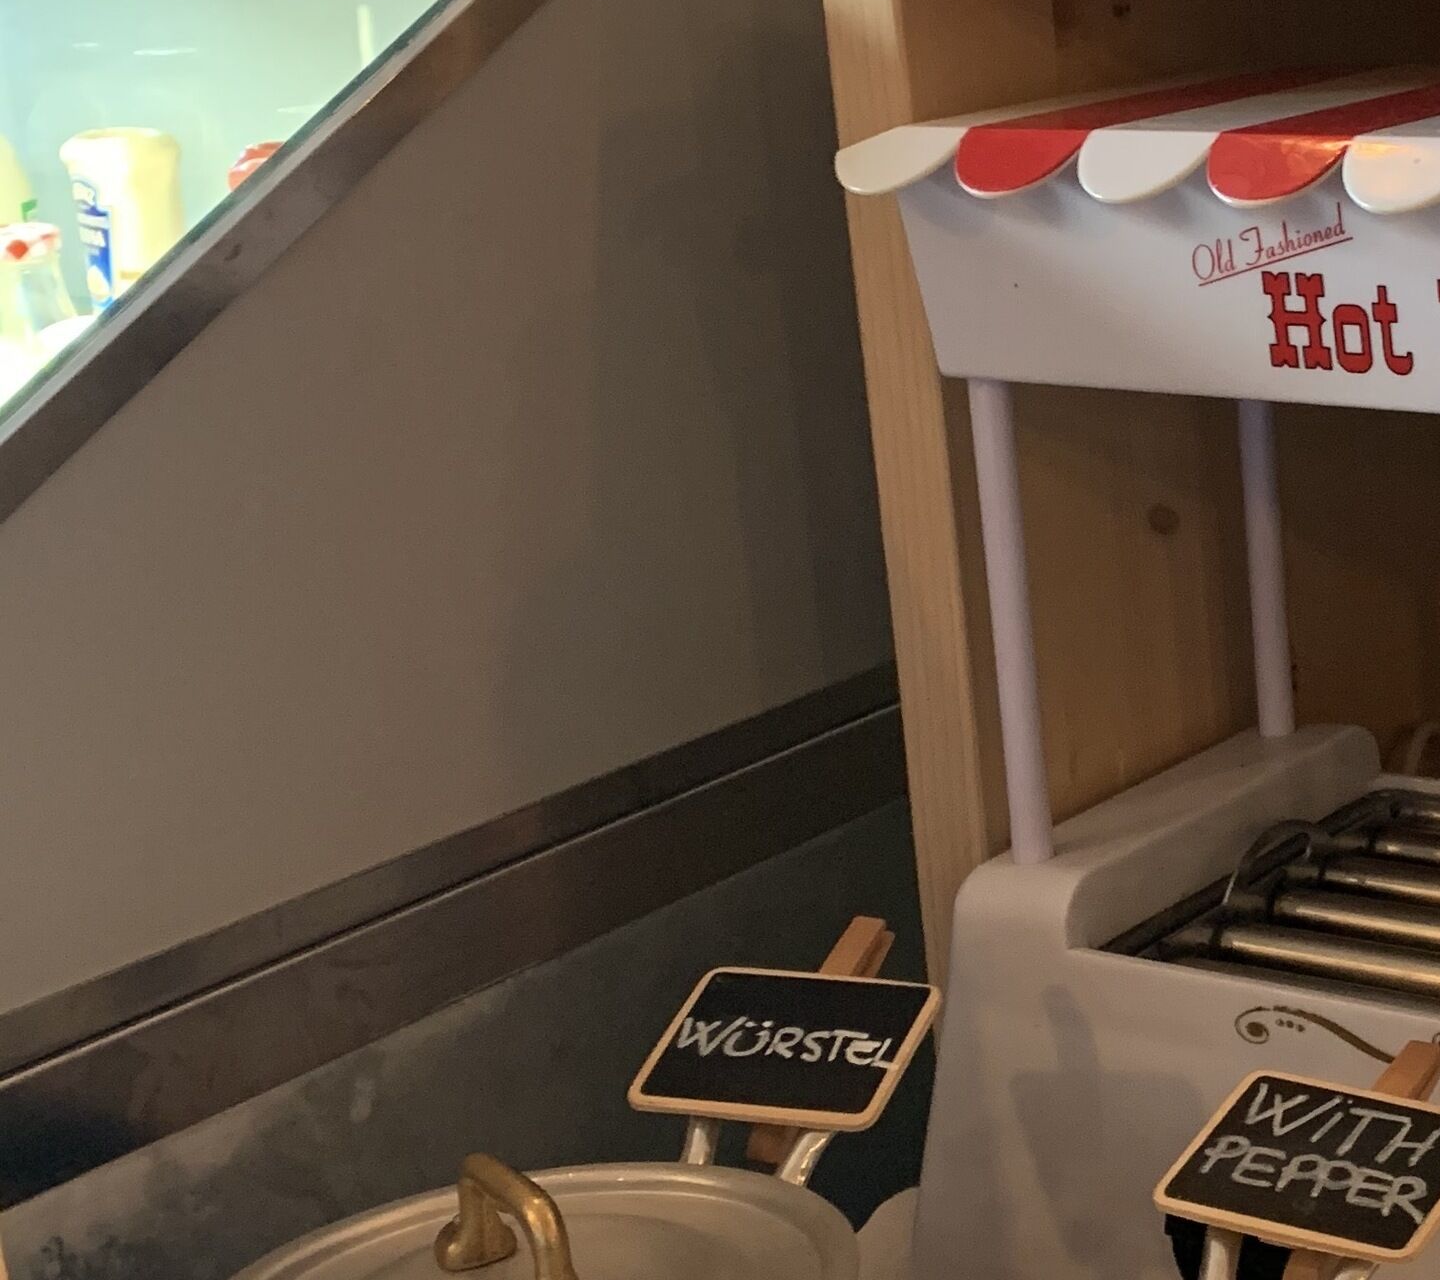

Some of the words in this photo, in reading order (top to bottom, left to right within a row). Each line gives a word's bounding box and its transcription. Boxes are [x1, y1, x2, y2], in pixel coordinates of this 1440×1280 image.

[1191, 237, 1237, 282] Old
[1240, 203, 1348, 266] Fashioned
[1261, 271, 1414, 376] Hot
[1200, 1134, 1426, 1225] PEPPER
